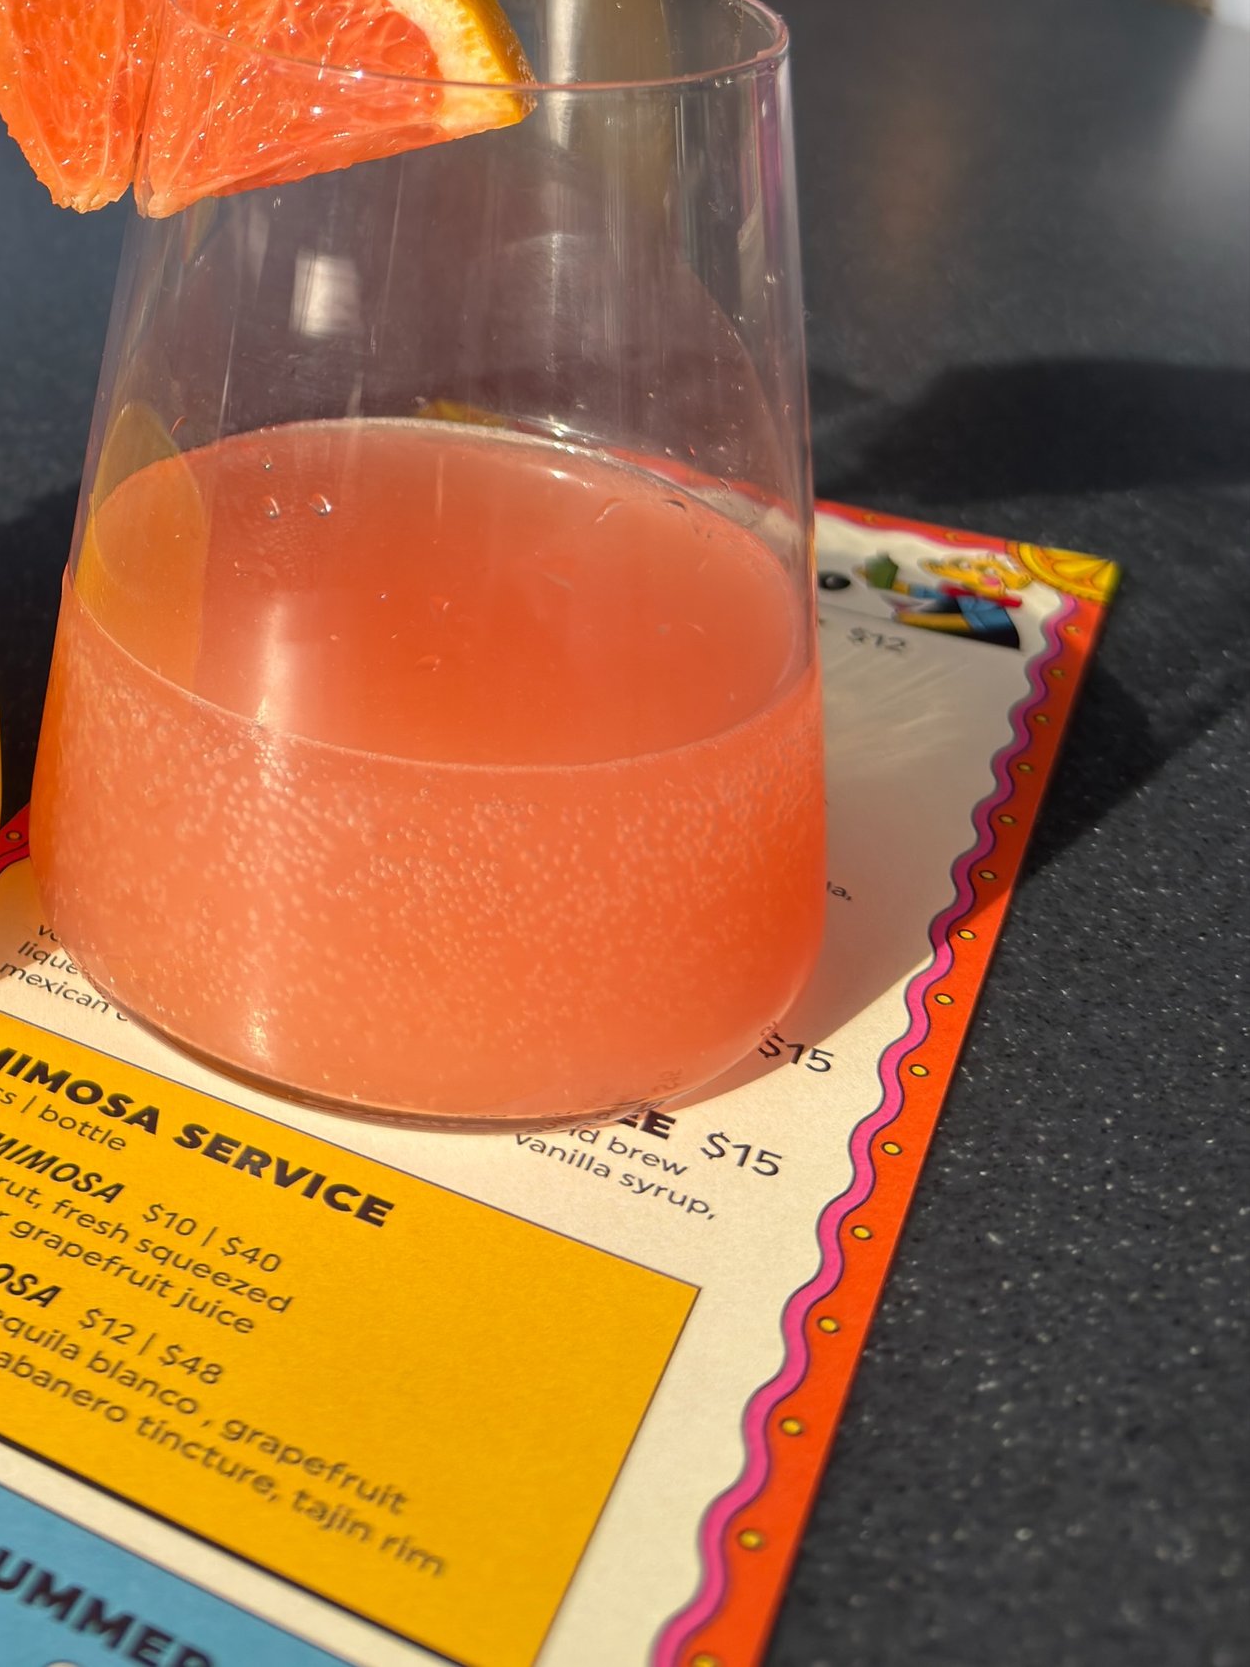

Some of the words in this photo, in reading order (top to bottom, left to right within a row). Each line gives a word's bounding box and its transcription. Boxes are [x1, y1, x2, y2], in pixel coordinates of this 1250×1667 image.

[0, 962, 109, 1013] mexican
[17, 940, 78, 975] lique
[757, 1031, 834, 1073] $15
[38, 1104, 127, 1151] bottle
[607, 1136, 688, 1176] brew
[700, 1131, 784, 1177] $15
[173, 1122, 395, 1227] SERVICE
[515, 1133, 611, 1178] vanilla
[617, 1172, 717, 1221] syrup,
[51, 1198, 130, 1245] fresh
[134, 1237, 294, 1315] squeezed
[142, 1203, 197, 1237] $10
[220, 1235, 282, 1274] $40
[9, 1220, 175, 1300] grapefruit
[170, 1287, 256, 1334] juice
[78, 1307, 137, 1346] $12
[158, 1344, 225, 1385] $48
[135, 1415, 282, 1503] tincture,
[379, 1534, 447, 1578] rim
[222, 1417, 410, 1516] grapefruit
